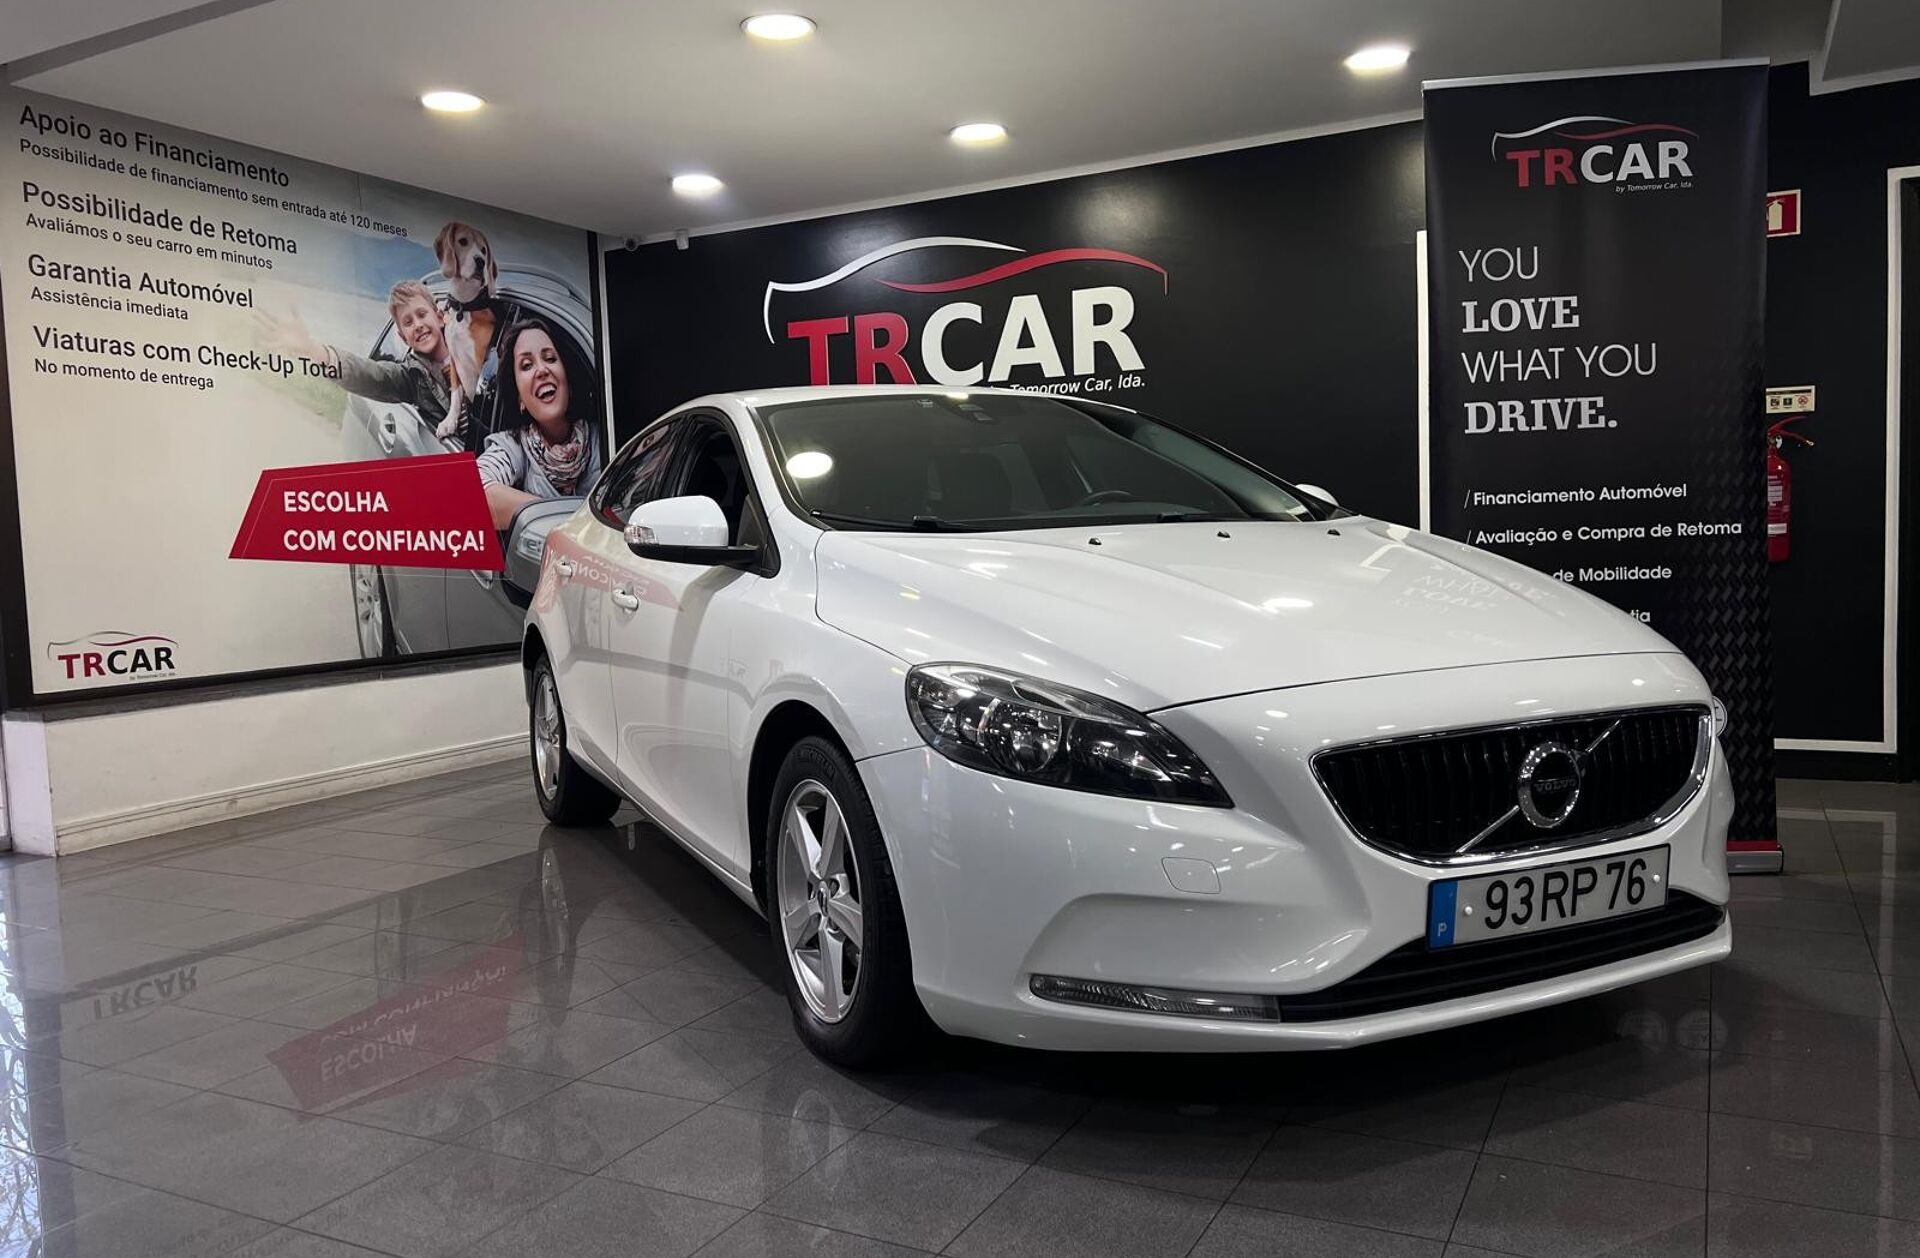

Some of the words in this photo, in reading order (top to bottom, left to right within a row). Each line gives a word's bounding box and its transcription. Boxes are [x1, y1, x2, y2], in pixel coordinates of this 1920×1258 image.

[20, 105, 91, 139] Apoio
[99, 128, 127, 148] ao
[135, 131, 289, 187] Financiamento
[1506, 140, 1693, 187] TRCAR
[20, 139, 125, 174] Possibilidade
[129, 163, 147, 178] de
[151, 167, 248, 201] financiamento
[251, 193, 278, 208] sem
[282, 199, 326, 219] entrada
[330, 210, 347, 223] até
[350, 214, 371, 229] 120
[373, 221, 408, 237] meses
[1615, 185, 1625, 193] by
[1627, 182, 1662, 191] Tomorrow
[23, 181, 183, 231] Possibilidade
[190, 216, 215, 238] de
[222, 221, 297, 254] Retoma
[26, 213, 108, 240] Avaliámos
[113, 231, 122, 242] o
[126, 233, 152, 248] seu
[156, 239, 192, 254] carro
[197, 247, 217, 259] em
[221, 250, 273, 269] minutos
[28, 254, 131, 289] Garantia
[139, 272, 253, 308] Automóvel
[1458, 246, 1538, 282] YOU
[31, 286, 122, 311] Assistência
[126, 299, 188, 320] imediata
[1462, 295, 1580, 333] LOVE
[33, 325, 136, 357] Viaturas
[143, 344, 191, 363] com
[197, 345, 294, 378] Check-Up
[299, 357, 343, 379] Total
[787, 286, 1146, 387] TRCAR
[35, 358, 57, 373] No
[62, 364, 136, 381] momento
[140, 368, 158, 383] de
[161, 375, 214, 390] entrega
[1461, 347, 1565, 384] WHAT
[1575, 342, 1657, 378] YOU
[1084, 377, 1113, 392] Car,
[1464, 396, 1618, 434] DRIVE.
[283, 490, 389, 513] ESCOLHA
[1599, 484, 1687, 501] Automóvel
[283, 530, 336, 552] COM
[342, 530, 485, 557] CONFIANÇA!
[1562, 530, 1573, 541] e
[1577, 526, 1645, 542] Compra
[1650, 523, 1672, 538] de
[1678, 522, 1742, 536] Retoma
[1579, 565, 1673, 582] Mobilidade
[57, 646, 175, 679] TRCAR
[1533, 778, 1577, 793] VOLVO
[1437, 923, 1448, 936] P
